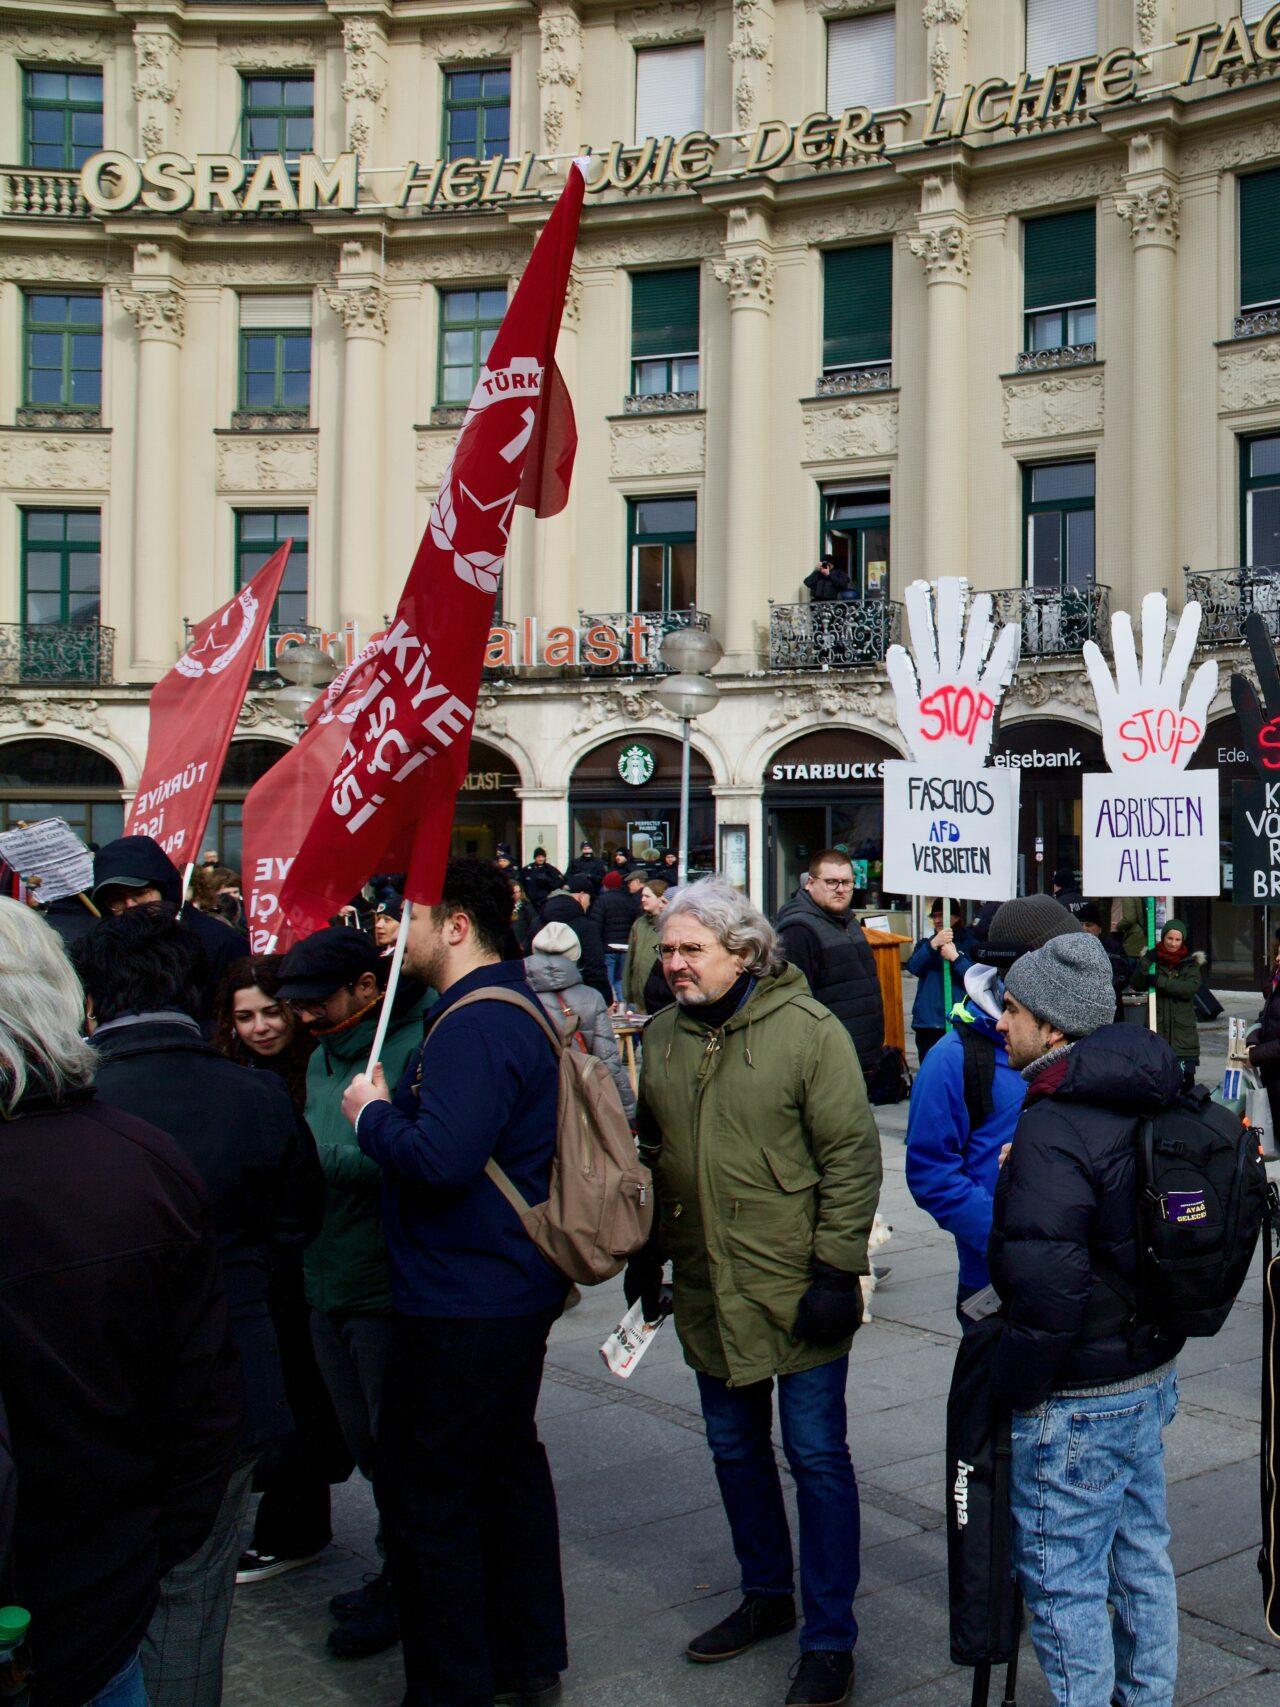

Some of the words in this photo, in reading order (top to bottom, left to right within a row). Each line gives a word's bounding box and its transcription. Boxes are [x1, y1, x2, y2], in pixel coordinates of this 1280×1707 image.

[80, 149, 360, 213] OSRAM
[395, 150, 542, 208] HELL
[747, 105, 887, 174] DER
[922, 47, 1141, 146] LICHTE
[482, 368, 544, 396] TÜRK
[484, 615, 652, 667] alast
[384, 619, 473, 747] KİYE
[920, 684, 995, 745] STOP
[1119, 708, 1201, 764] STOP
[772, 763, 885, 780] STARBUCKS
[994, 747, 1082, 768] eisebank.
[1217, 747, 1249, 763] Ede
[460, 772, 501, 790] ALAST
[908, 778, 995, 816] FASCHOS
[928, 820, 961, 843] AFD
[1095, 796, 1204, 838] ABRÜSTEN
[912, 843, 991, 875] VERBIETEN
[1118, 848, 1171, 883] ALLE
[954, 1459, 974, 1527] hama
